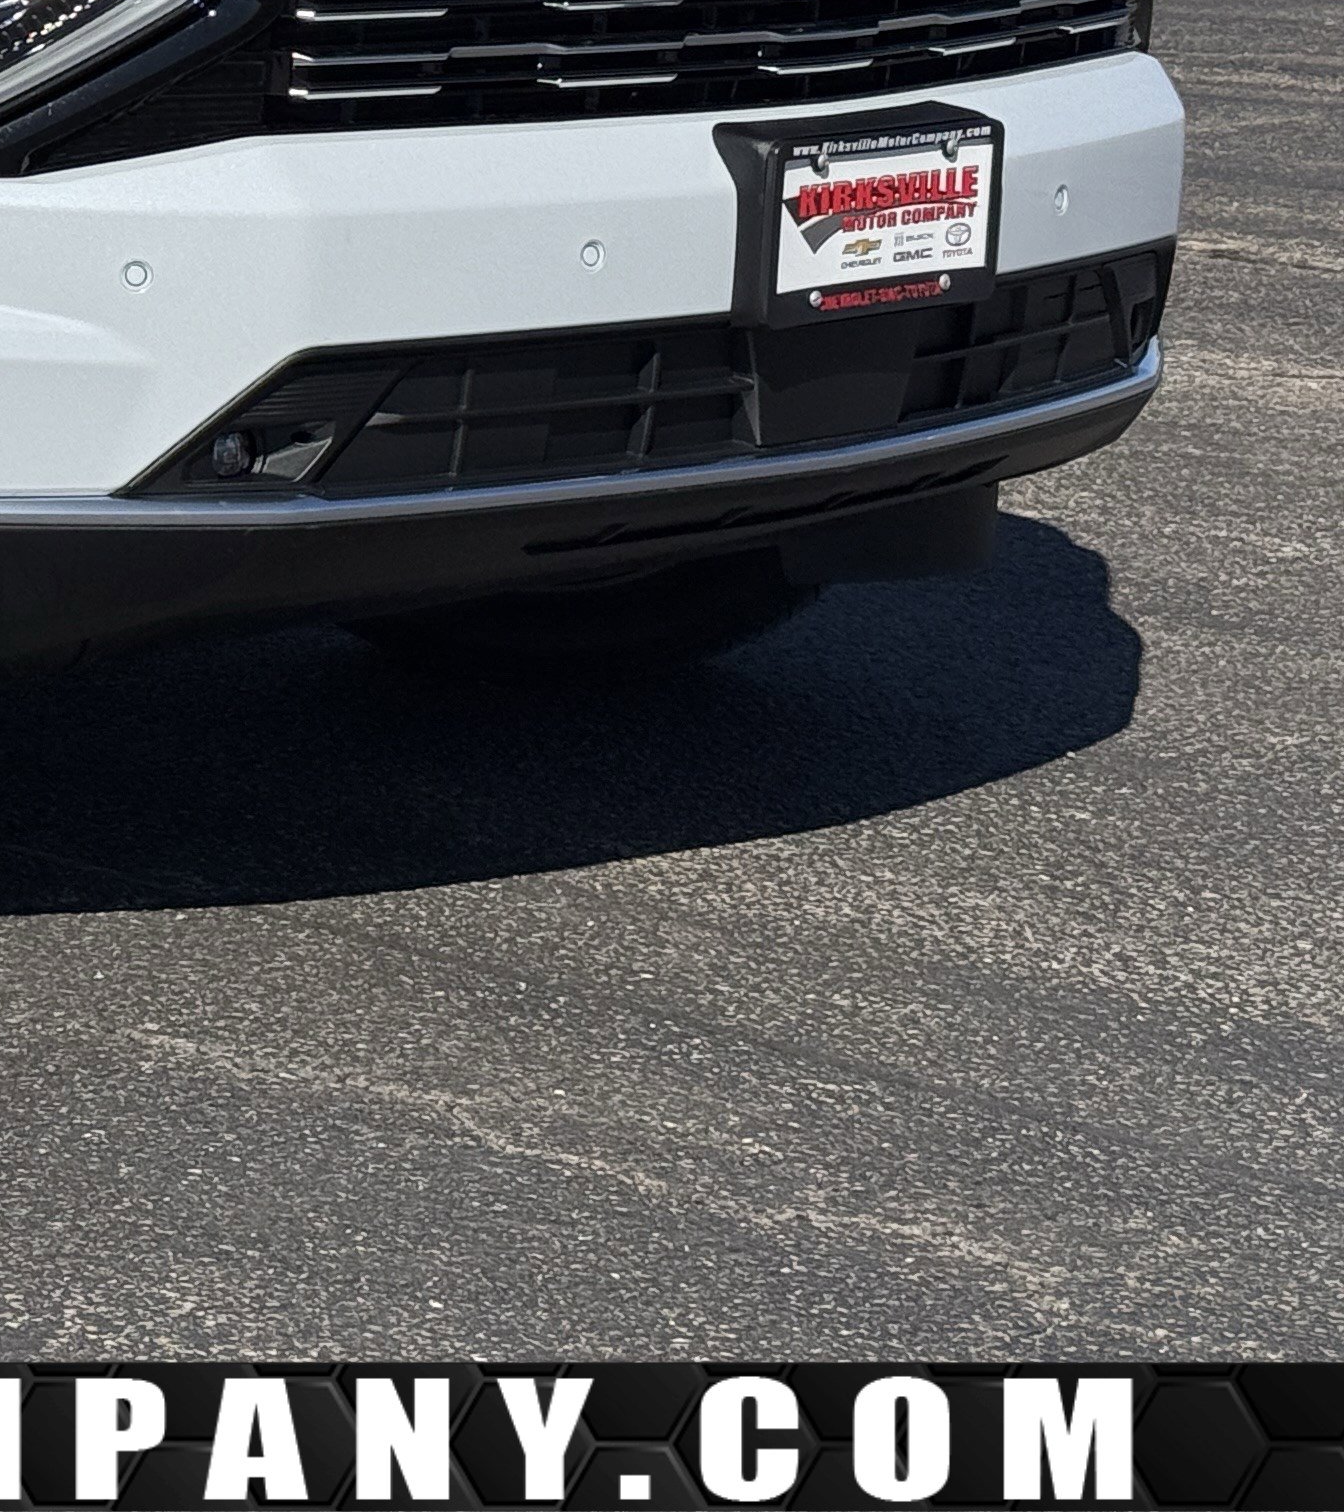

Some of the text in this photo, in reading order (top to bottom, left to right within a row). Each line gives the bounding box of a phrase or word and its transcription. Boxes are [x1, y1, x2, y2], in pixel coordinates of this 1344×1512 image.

[798, 165, 979, 219] KIRKSVILLE
[841, 202, 977, 233] MOTOR COMPANY
[893, 247, 934, 263] GMC
